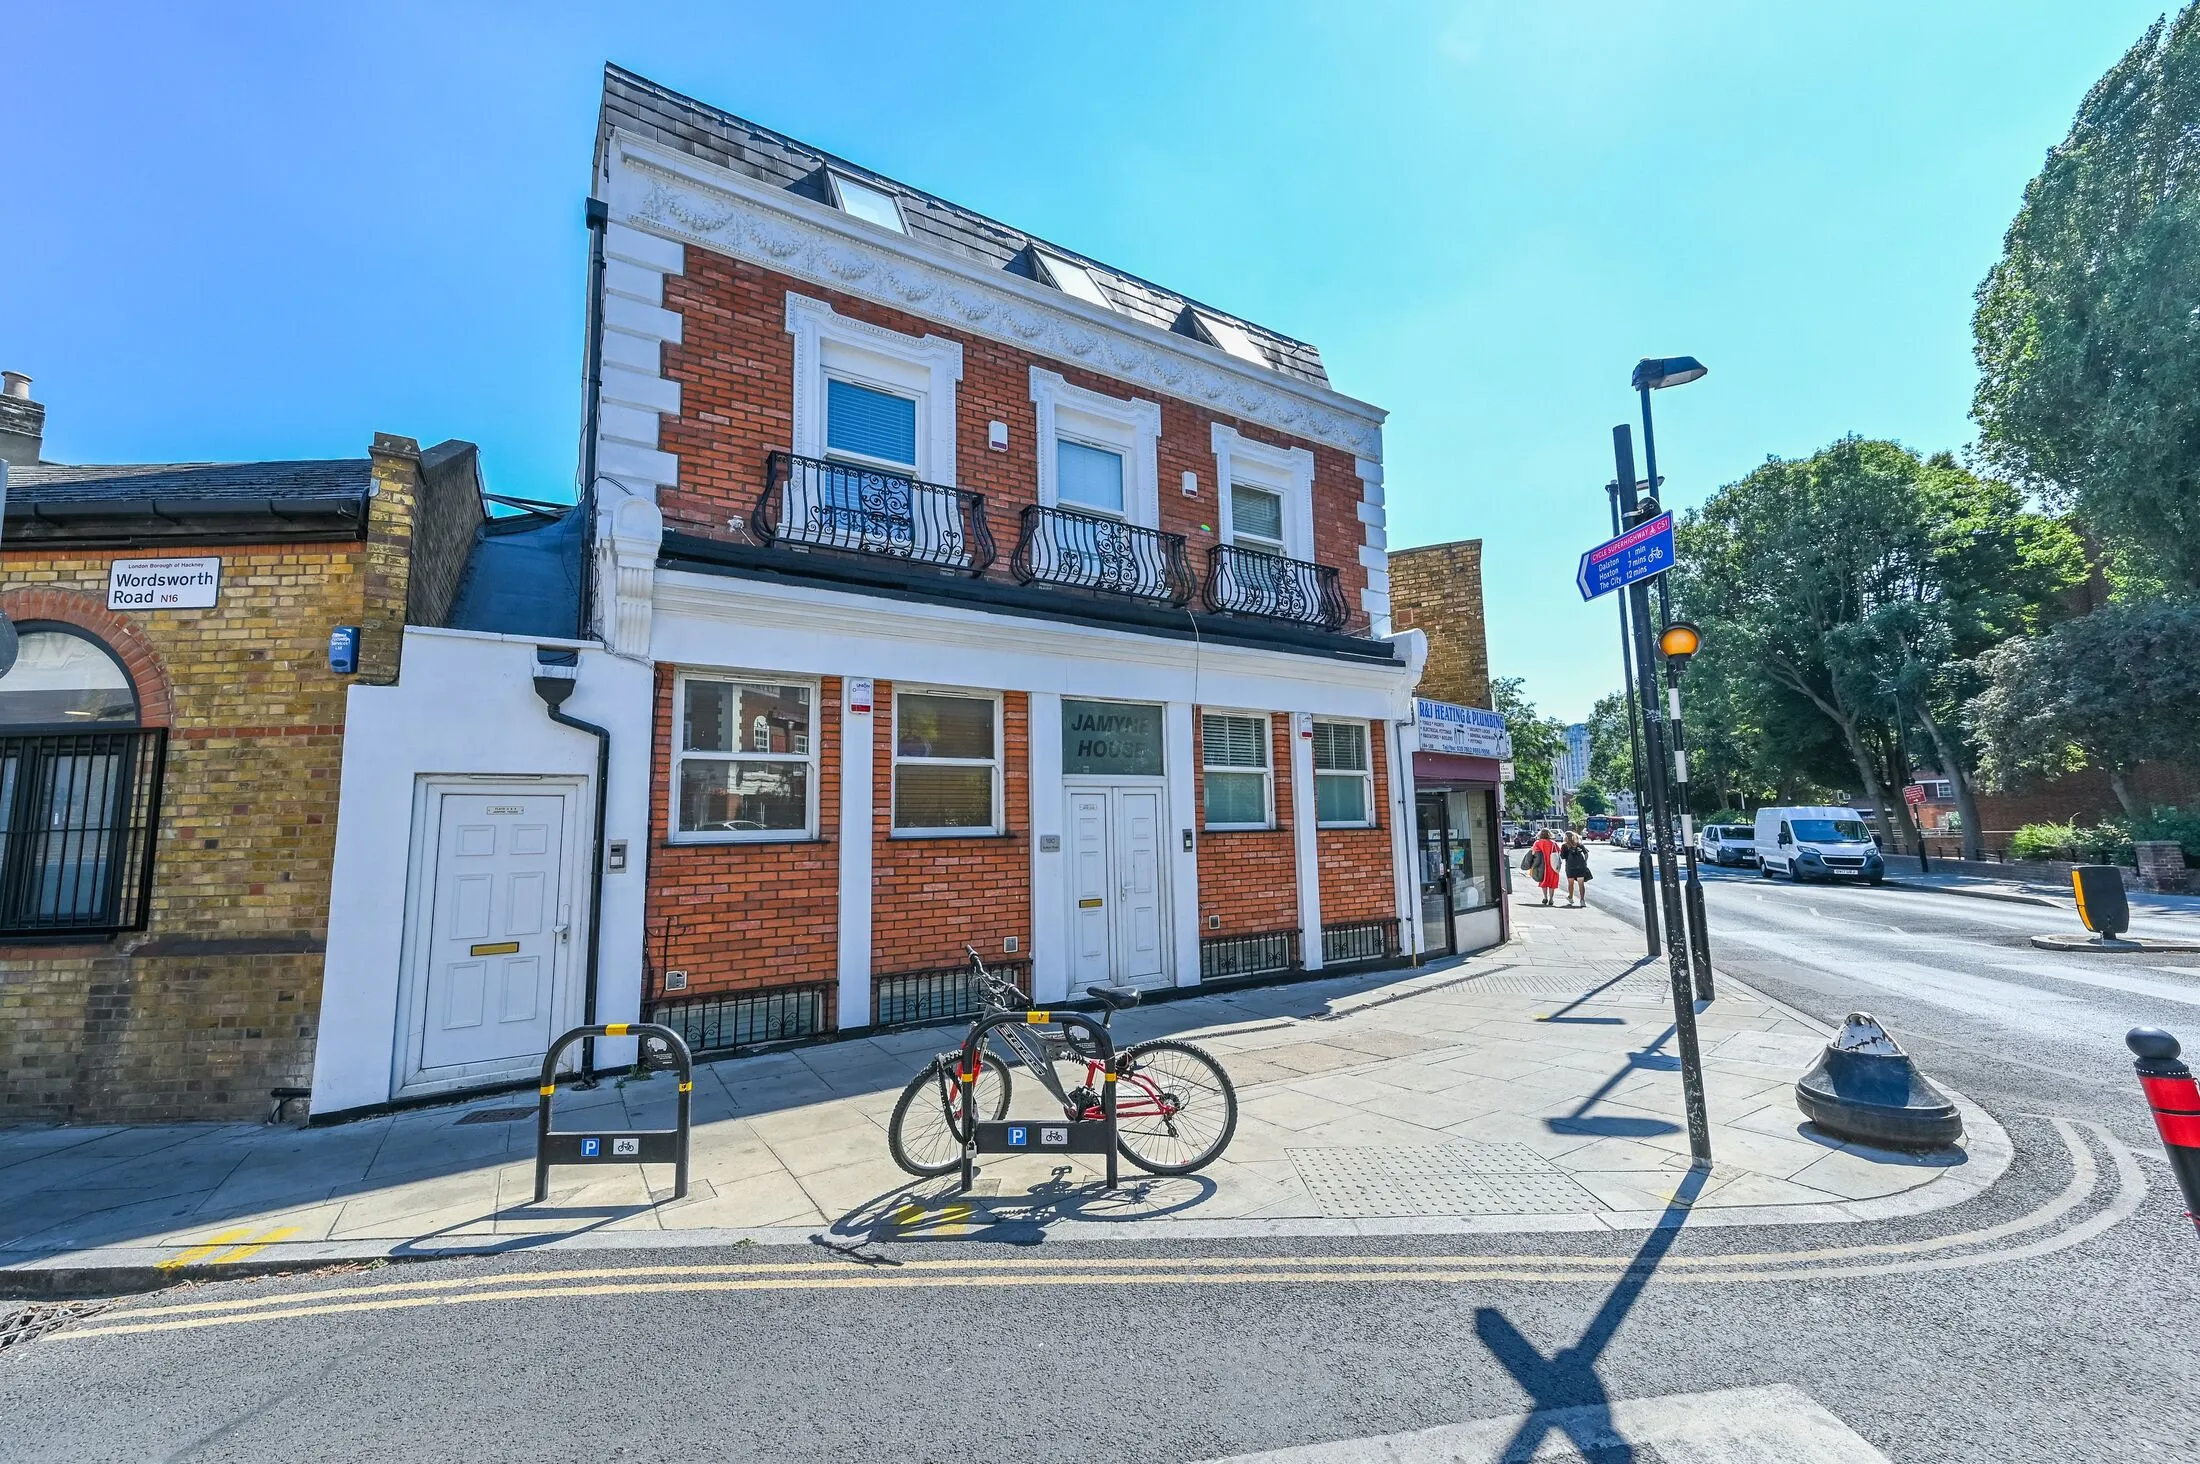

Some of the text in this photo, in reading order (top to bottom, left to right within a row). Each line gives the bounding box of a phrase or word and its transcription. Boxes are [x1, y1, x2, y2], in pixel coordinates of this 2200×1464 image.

[1592, 549, 1607, 561] CYCLE
[1607, 529, 1648, 555] SUPERHIGHWAY
[1598, 558, 1620, 571] Dalston
[1634, 545, 1646, 556] min
[1599, 567, 1619, 581] Hoxton
[1632, 556, 1647, 567] mins
[116, 571, 213, 587] Wordsworth
[1599, 565, 1648, 591] The City 12 mins
[113, 590, 179, 604] Road N16
[1434, 704, 1465, 724] HEATING
[1465, 710, 1471, 724] &
[1471, 711, 1505, 730] PLUMBING
[585, 1140, 596, 1155] P
[1012, 1129, 1023, 1143] P
